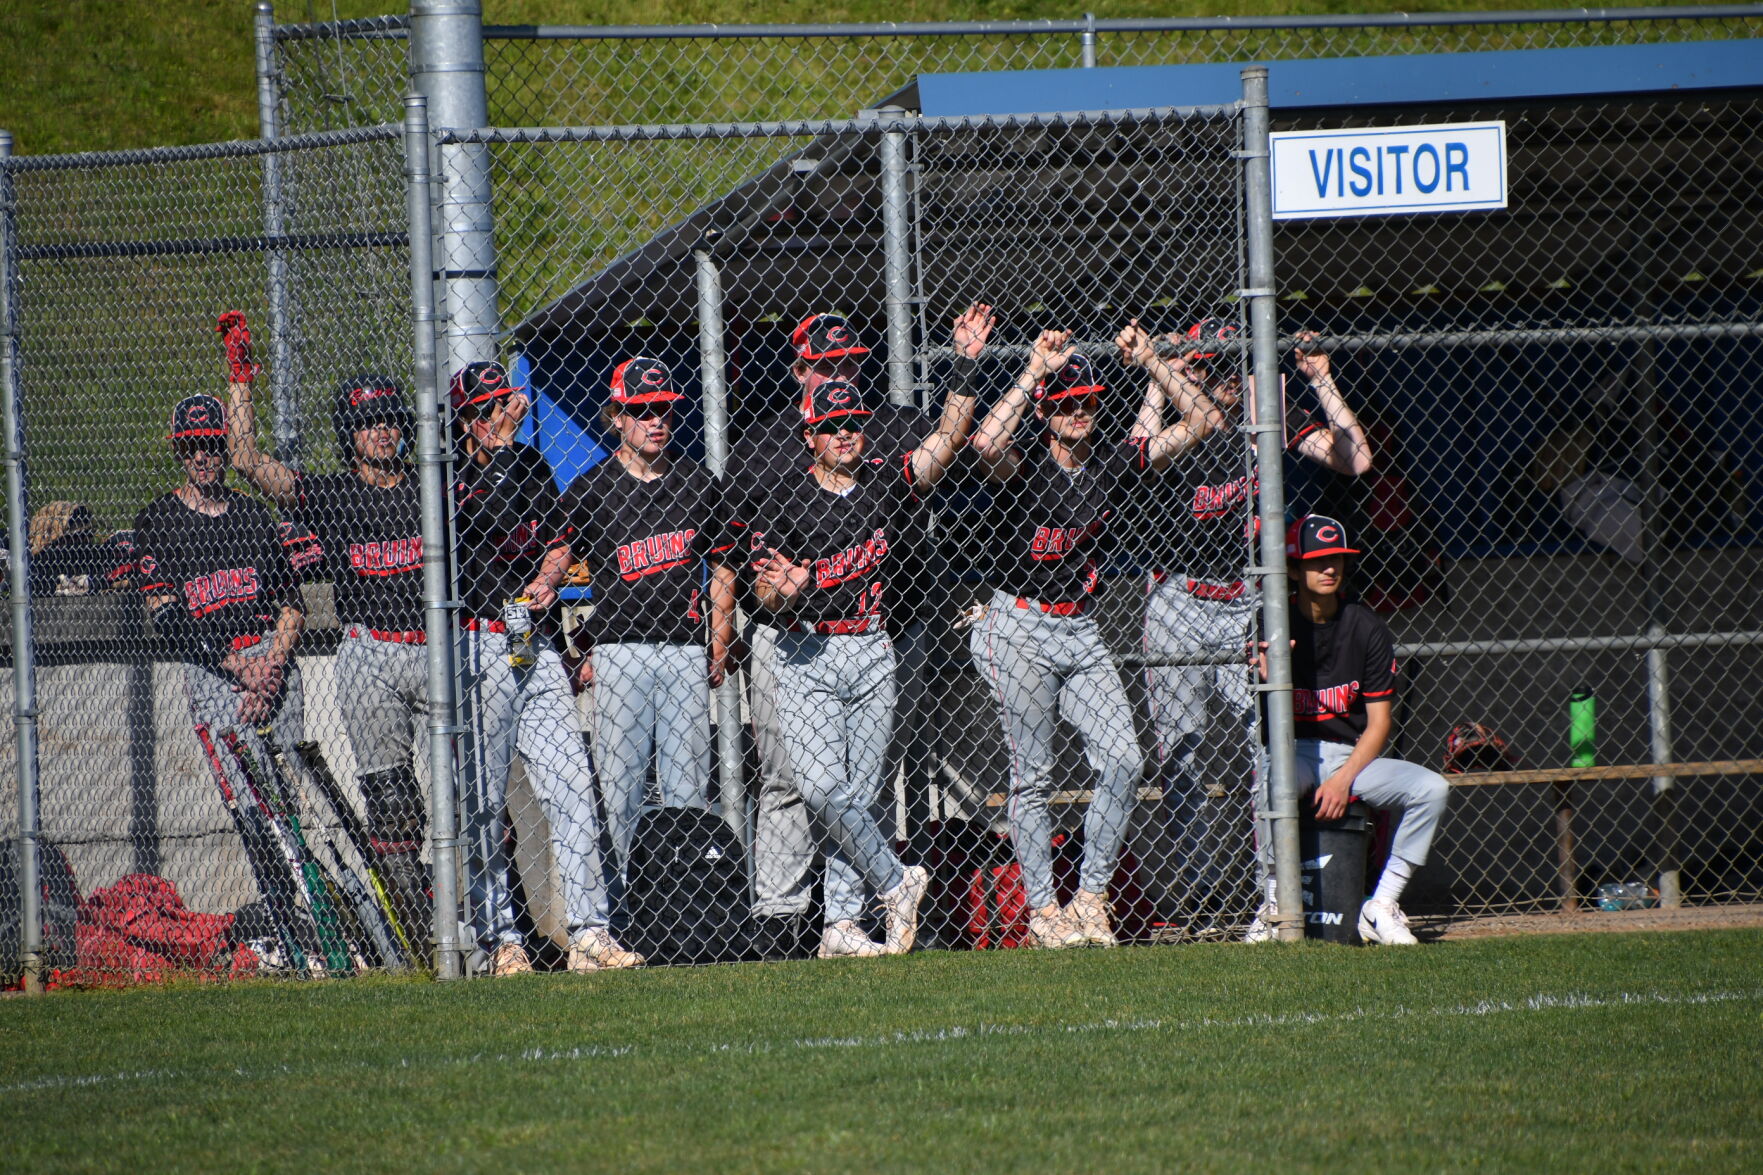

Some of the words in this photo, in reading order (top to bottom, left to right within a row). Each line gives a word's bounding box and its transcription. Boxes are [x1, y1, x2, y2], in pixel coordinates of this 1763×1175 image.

[1309, 142, 1470, 199] VISITOR
[826, 326, 849, 342] C
[642, 368, 664, 385] C
[827, 388, 851, 404] C
[1316, 526, 1339, 543] C
[617, 528, 696, 574] BRUINS
[816, 528, 888, 585] BRUINS
[687, 588, 700, 625] 4
